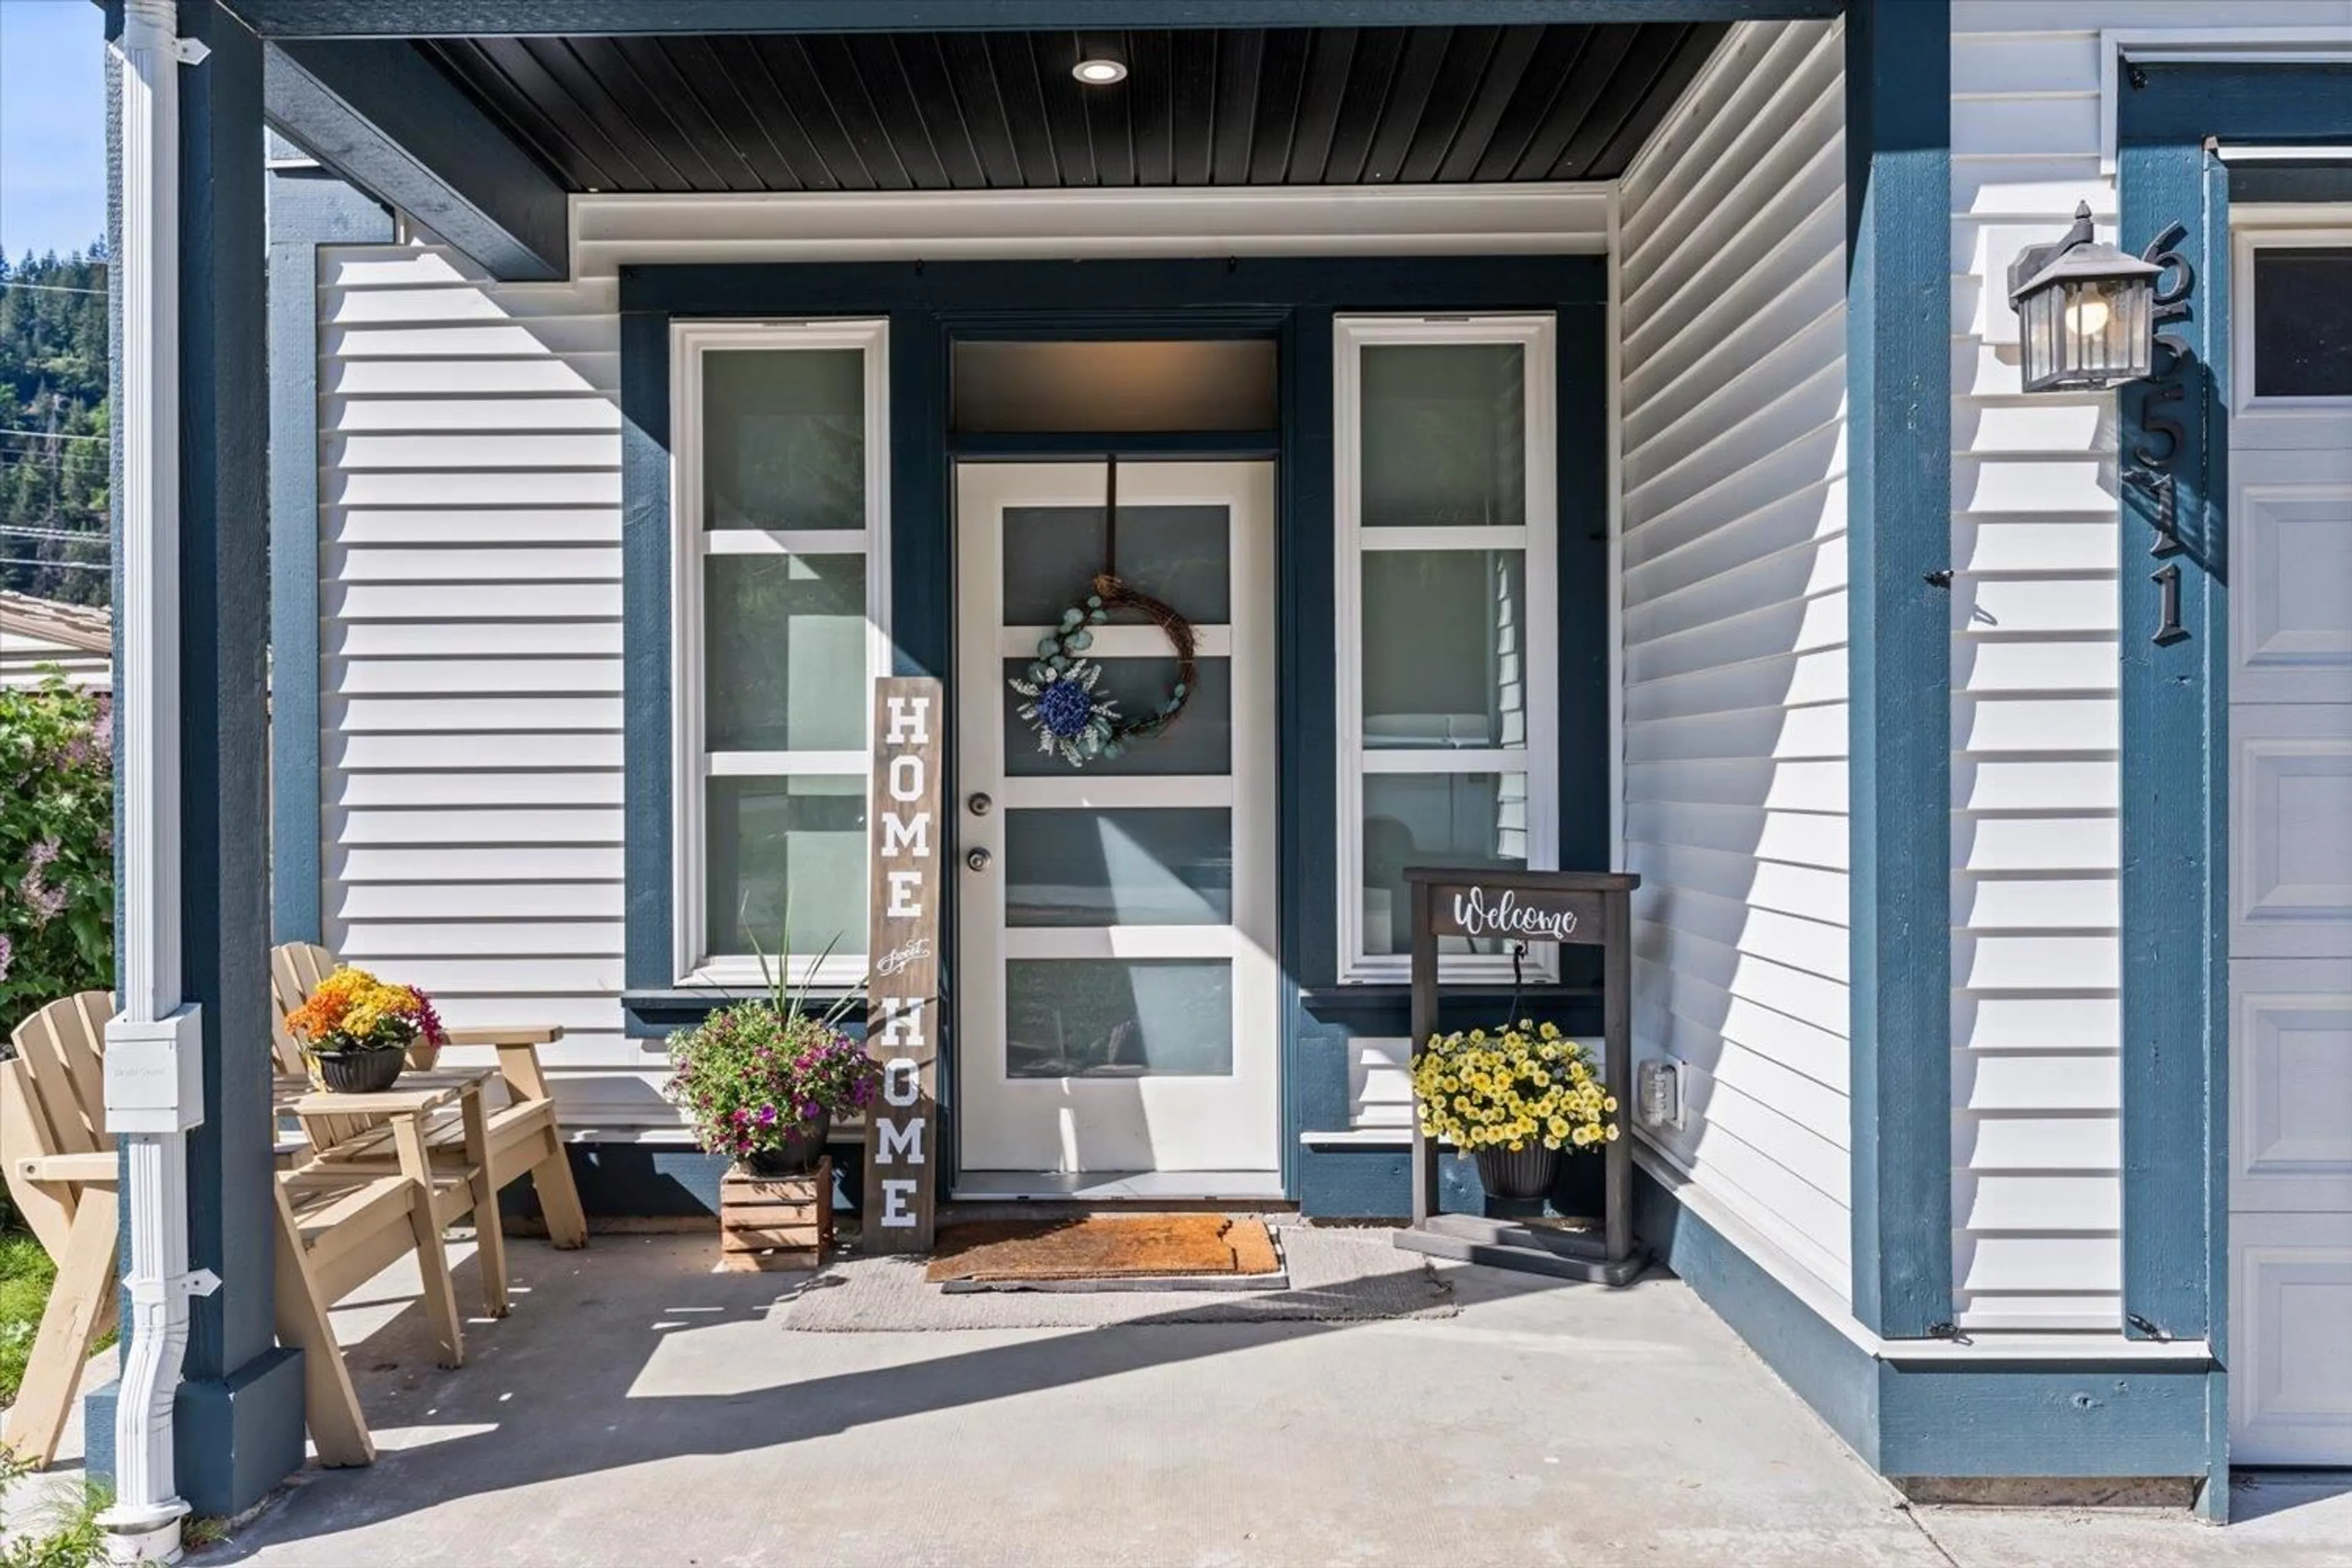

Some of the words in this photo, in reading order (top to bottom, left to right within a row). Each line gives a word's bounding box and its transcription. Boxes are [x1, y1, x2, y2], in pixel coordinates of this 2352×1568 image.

[881, 696, 930, 918] HOME
[1453, 886, 1578, 940] Welcome
[875, 997, 926, 1227] HOME
